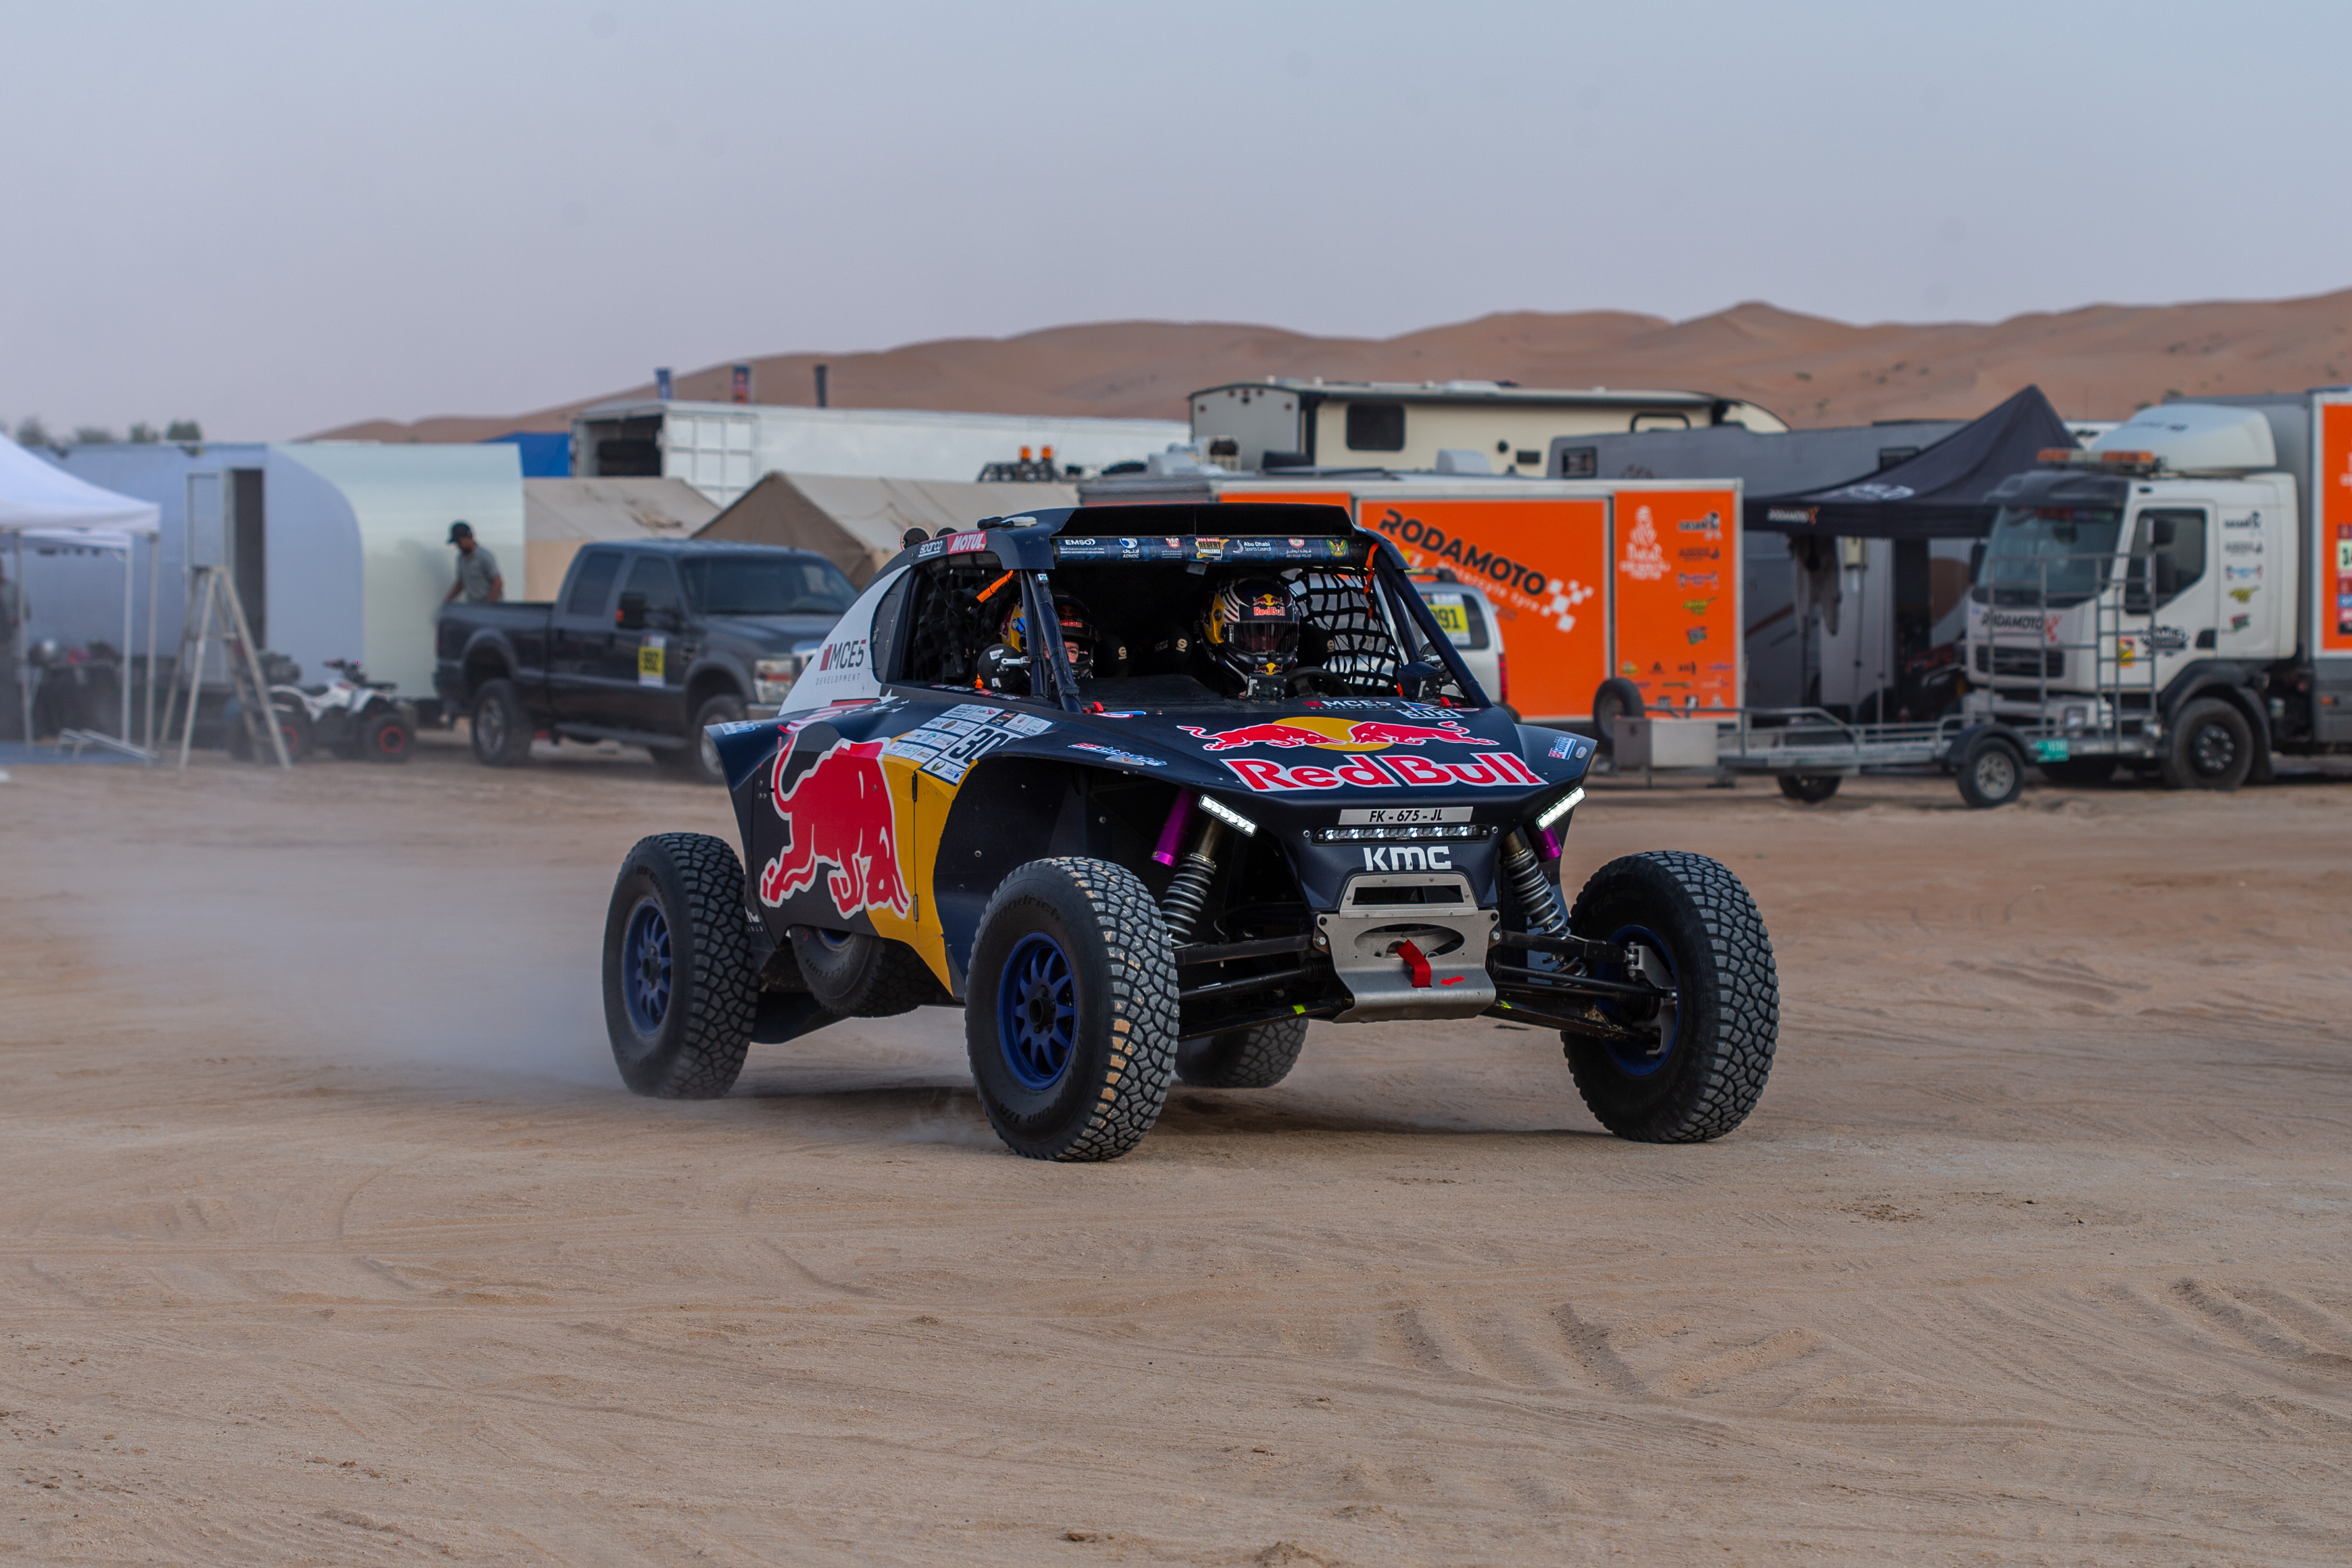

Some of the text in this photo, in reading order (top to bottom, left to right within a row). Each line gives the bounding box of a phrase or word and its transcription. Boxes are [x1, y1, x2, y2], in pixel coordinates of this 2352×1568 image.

[920, 540, 944, 555] sparco
[950, 533, 984, 552] MOTUL
[1379, 508, 1547, 596] RODAMOTO
[1253, 606, 1285, 616] Red Bull
[829, 639, 867, 671] MCE5
[815, 672, 861, 686] DEVELOPMENT
[948, 728, 1020, 766] 30
[1221, 752, 1548, 792] Red Bull
[1369, 810, 1387, 822] FK
[1396, 810, 1420, 822] 675
[1430, 809, 1443, 821] JL
